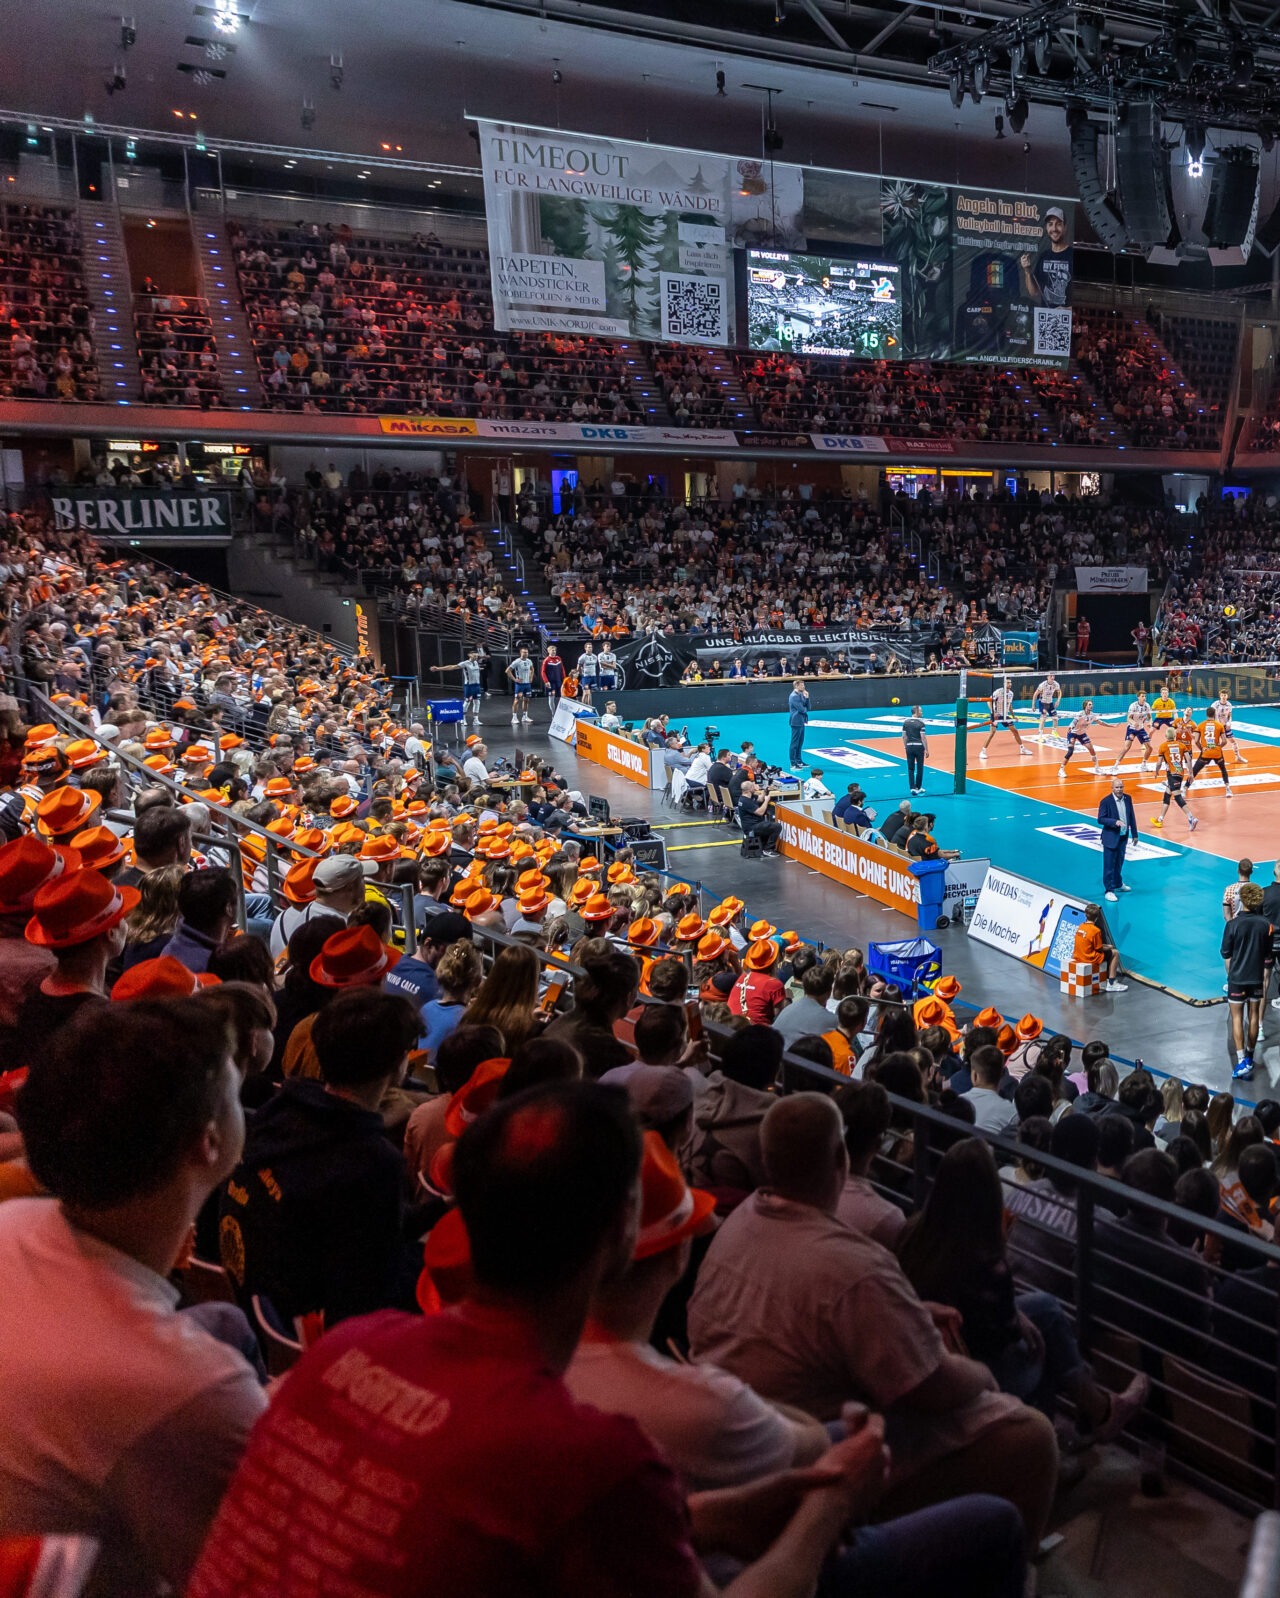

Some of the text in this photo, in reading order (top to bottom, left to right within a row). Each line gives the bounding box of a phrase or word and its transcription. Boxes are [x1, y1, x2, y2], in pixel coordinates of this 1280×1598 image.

[491, 137, 629, 178] TIMEOUT
[494, 169, 720, 212] FÜR LANGWEILIGE WÄNDE!
[956, 195, 1040, 221] Angeln im Blut,
[956, 216, 1043, 238] Volleyball im Herzen
[496, 256, 577, 279] TAPETEN,
[498, 273, 590, 293] WANDSTICKER
[796, 273, 804, 286] 2
[822, 276, 830, 289] 3
[575, 296, 601, 306] MEHR
[776, 325, 793, 342] 18
[861, 332, 879, 348] 15
[801, 344, 852, 357] ticketmaster
[490, 424, 557, 436] mazars
[581, 427, 628, 439] DKB
[142, 443, 159, 452] Bar
[235, 446, 251, 454] Bar
[823, 437, 863, 449] DKB
[52, 497, 226, 534] BERLINER
[1004, 642, 1024, 652] mkk
[635, 653, 673, 670] NISSAN
[1204, 731, 1215, 739] 21
[607, 743, 622, 764] STELL
[621, 749, 631, 769] DIR
[1170, 753, 1181, 762] 13
[778, 820, 798, 847] WAS
[798, 828, 824, 859] WÄRE
[824, 841, 857, 876] BERLIN
[859, 856, 887, 888] OHNE
[986, 874, 1019, 901] NOVEDAS
[973, 913, 1021, 944] Die Macher
[400, 979, 420, 994] CALLS
